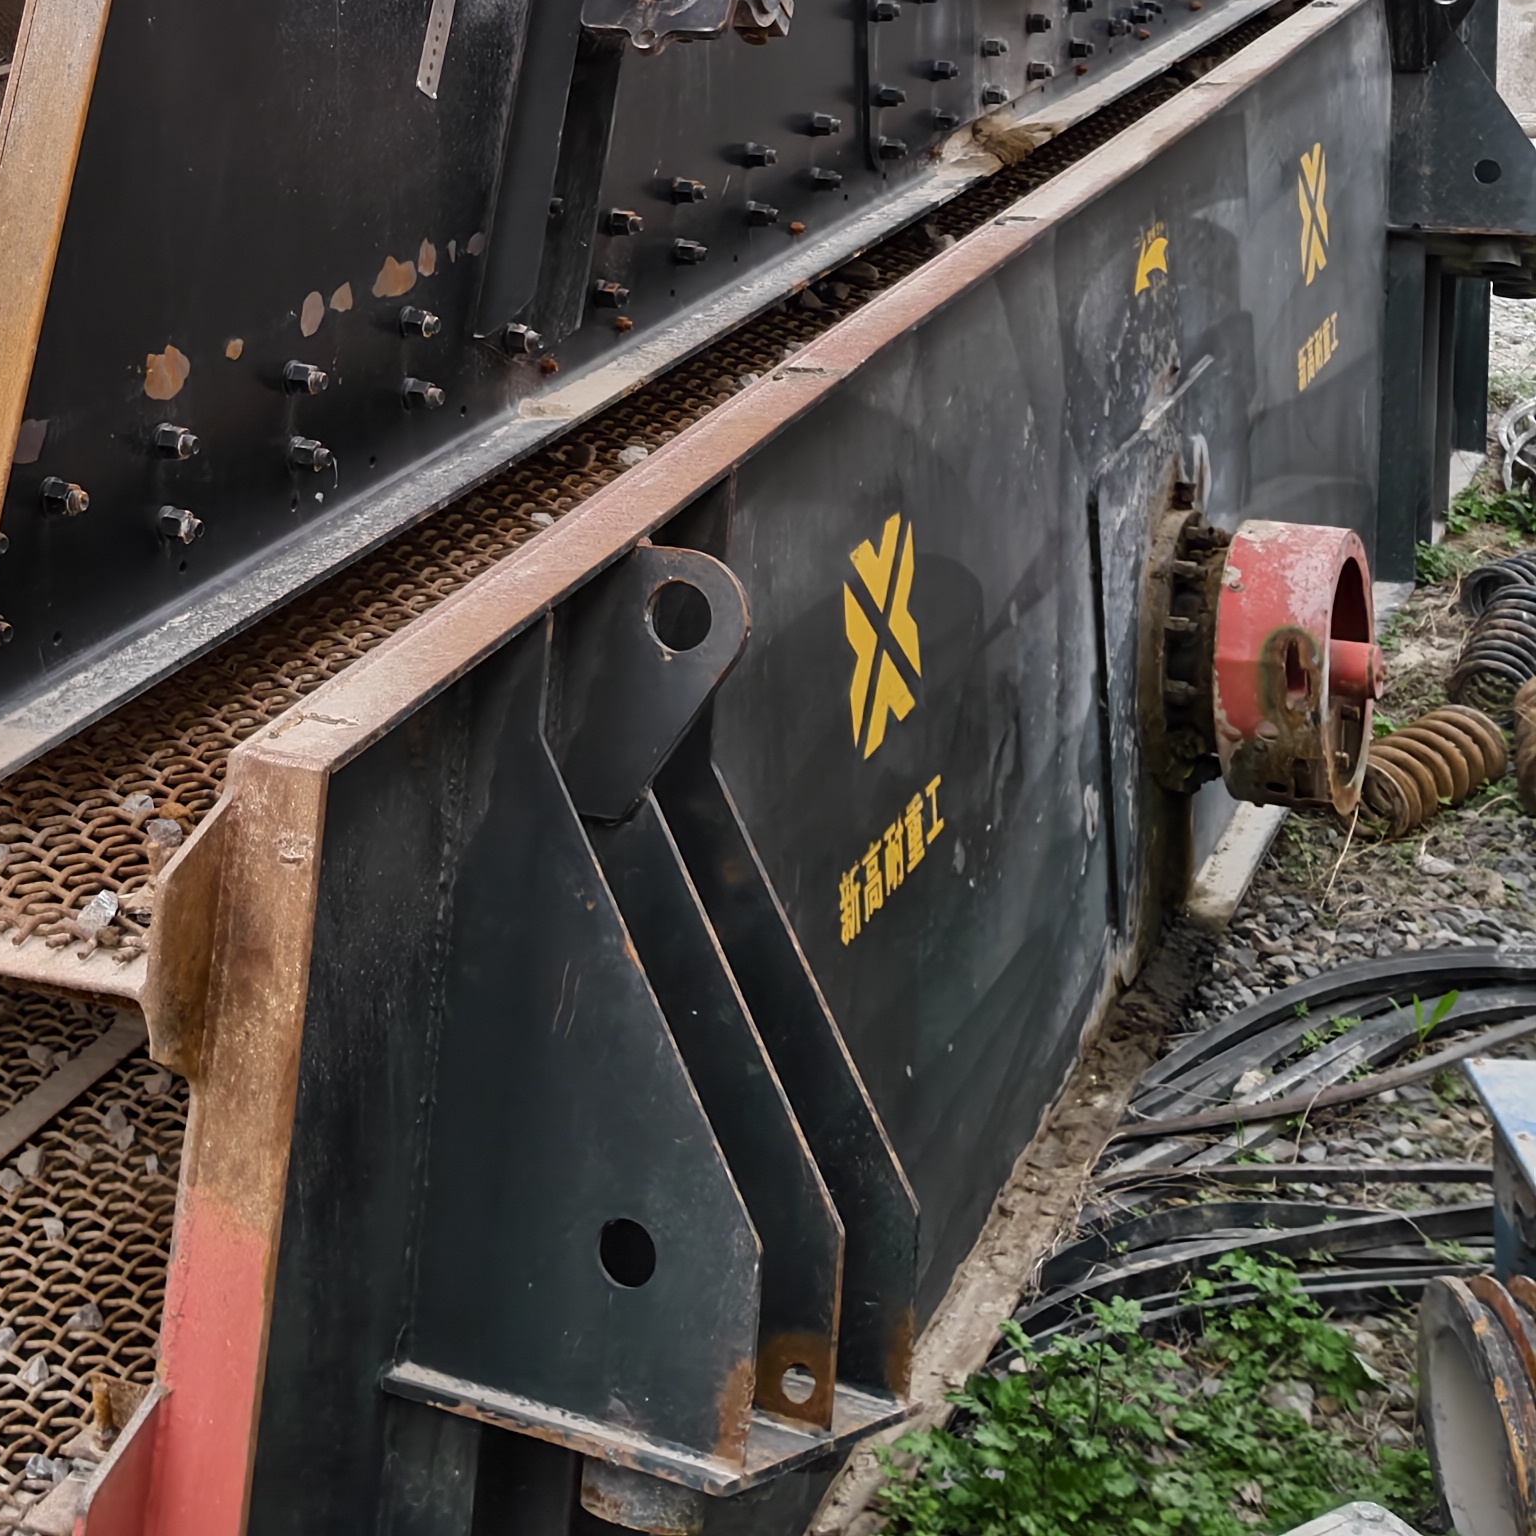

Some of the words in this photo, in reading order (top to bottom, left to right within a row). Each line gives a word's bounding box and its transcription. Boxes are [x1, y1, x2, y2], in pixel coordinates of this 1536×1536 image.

[839, 774, 944, 946] 新高耐重工
